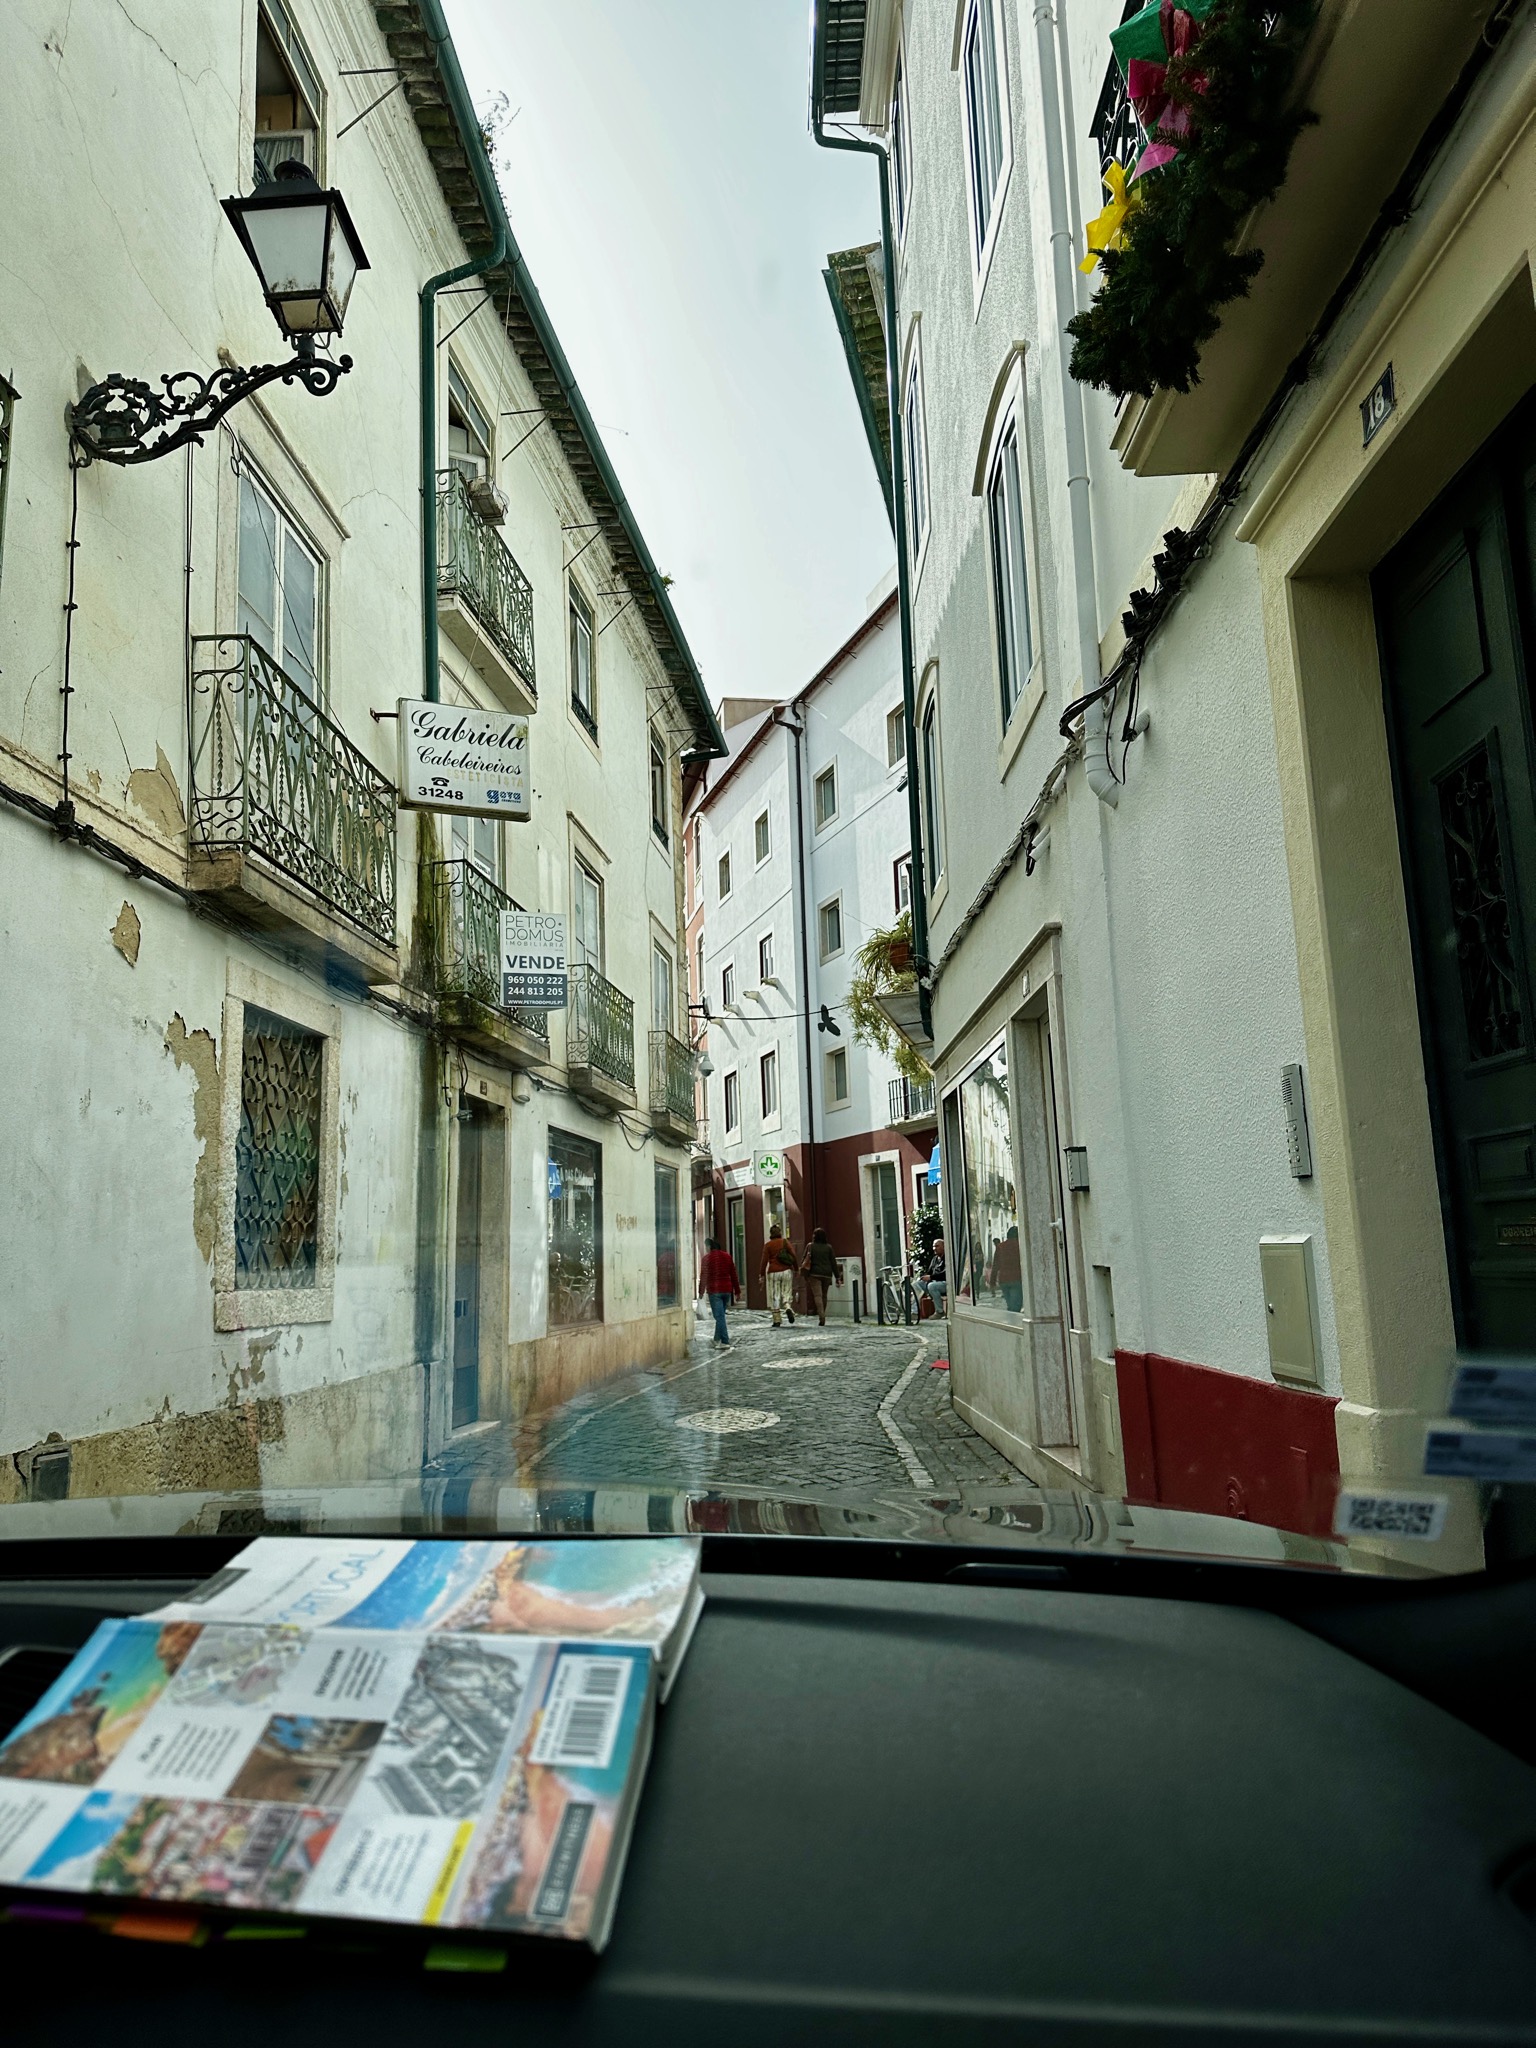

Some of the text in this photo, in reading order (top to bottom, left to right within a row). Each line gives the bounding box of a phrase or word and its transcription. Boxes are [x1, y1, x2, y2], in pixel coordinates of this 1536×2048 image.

[411, 710, 526, 750] Gabriela
[417, 745, 522, 775] Cabeleireiros
[418, 786, 464, 800] 31248
[505, 928, 564, 942] DOMUS
[506, 955, 565, 970] VENDE
[507, 975, 563, 985] 969 050 222
[507, 987, 563, 996] 244 813 205
[265, 1548, 385, 1622] RTUGAL
